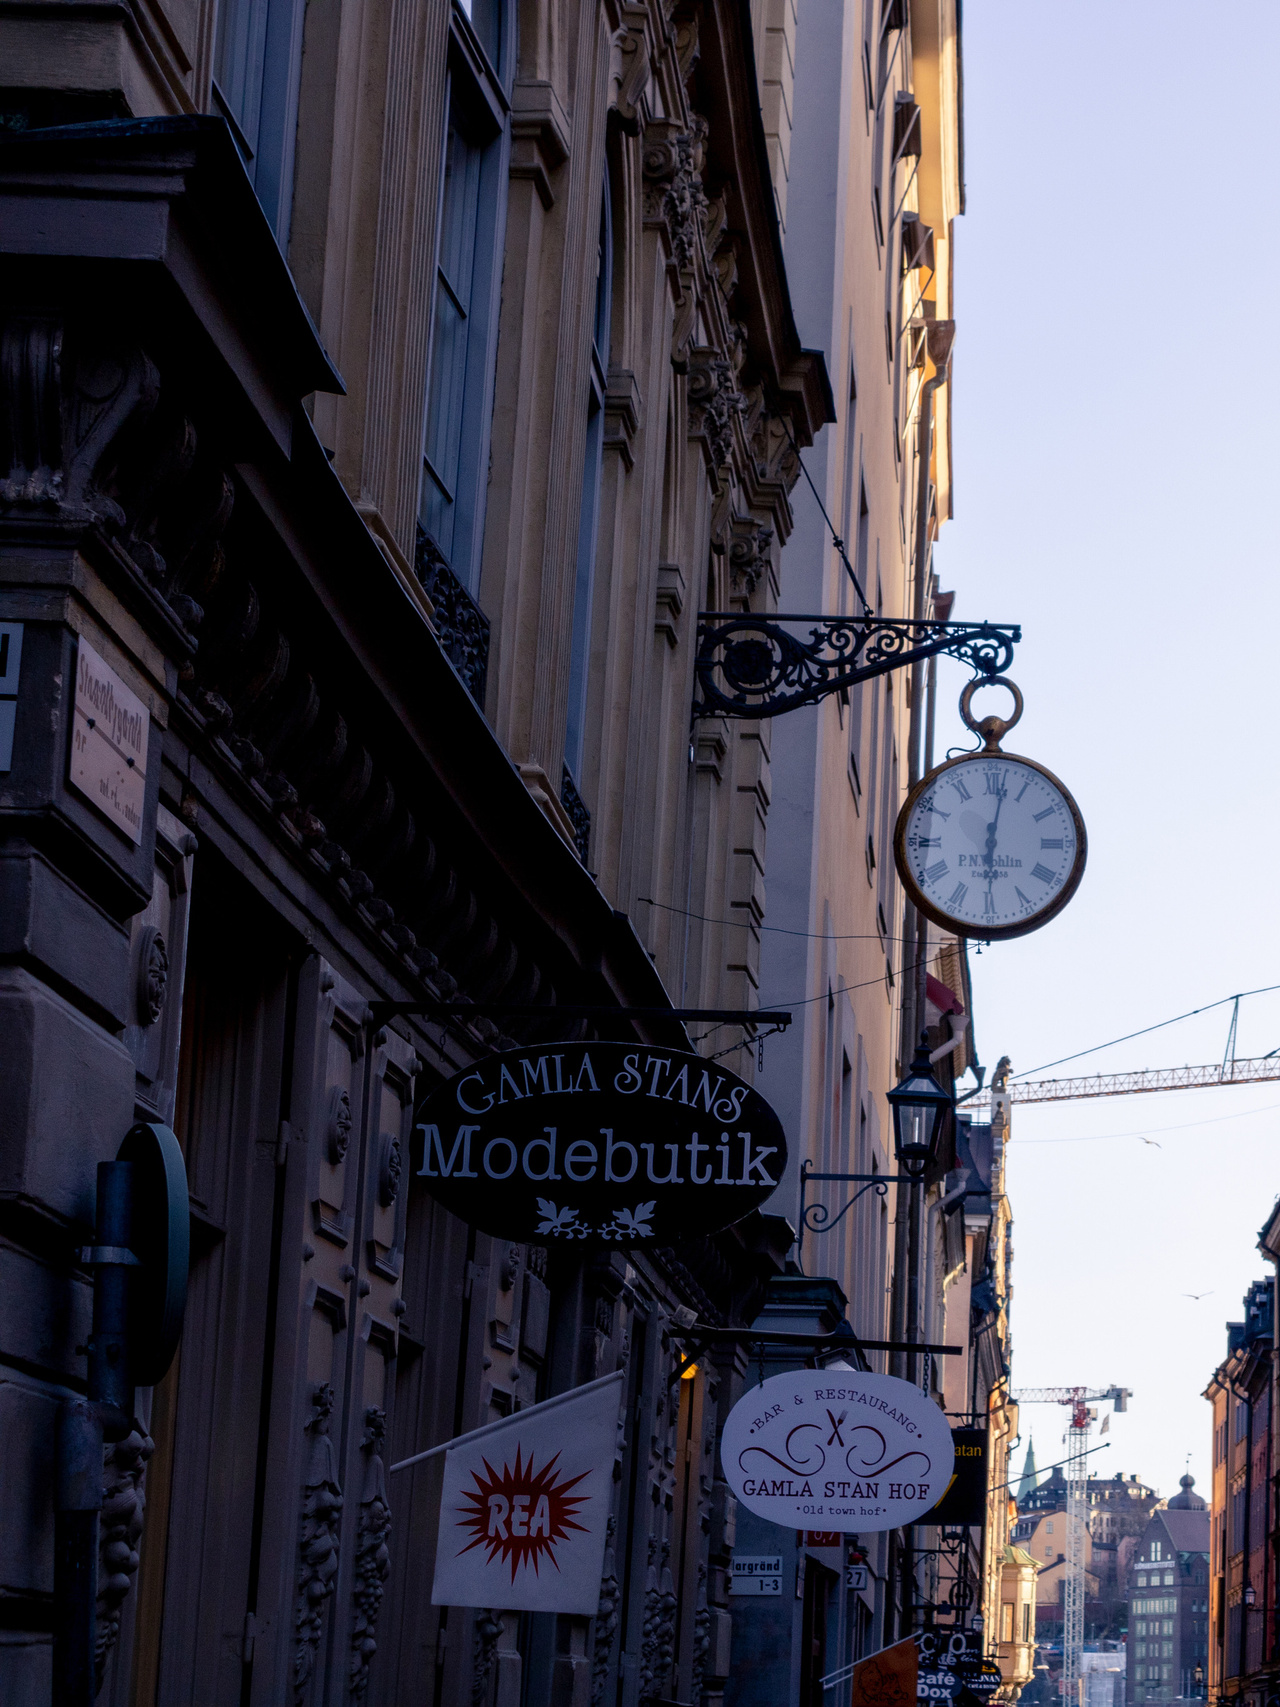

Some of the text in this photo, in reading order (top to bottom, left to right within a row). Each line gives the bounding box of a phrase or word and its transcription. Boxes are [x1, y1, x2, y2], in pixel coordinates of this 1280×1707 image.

[456, 1052, 751, 1124] GAMLA STANS
[415, 1123, 779, 1187] Modebutik
[753, 1388, 918, 1435] BAR & RESTAURANG
[954, 1444, 982, 1457] atan
[742, 1479, 931, 1501] GAMLA STAN HOF
[487, 1493, 551, 1541] REA
[802, 1505, 882, 1516] Old town hof
[759, 1579, 779, 1591] 1-3
[847, 1571, 862, 1586] 27
[917, 1671, 956, 1686] Café
